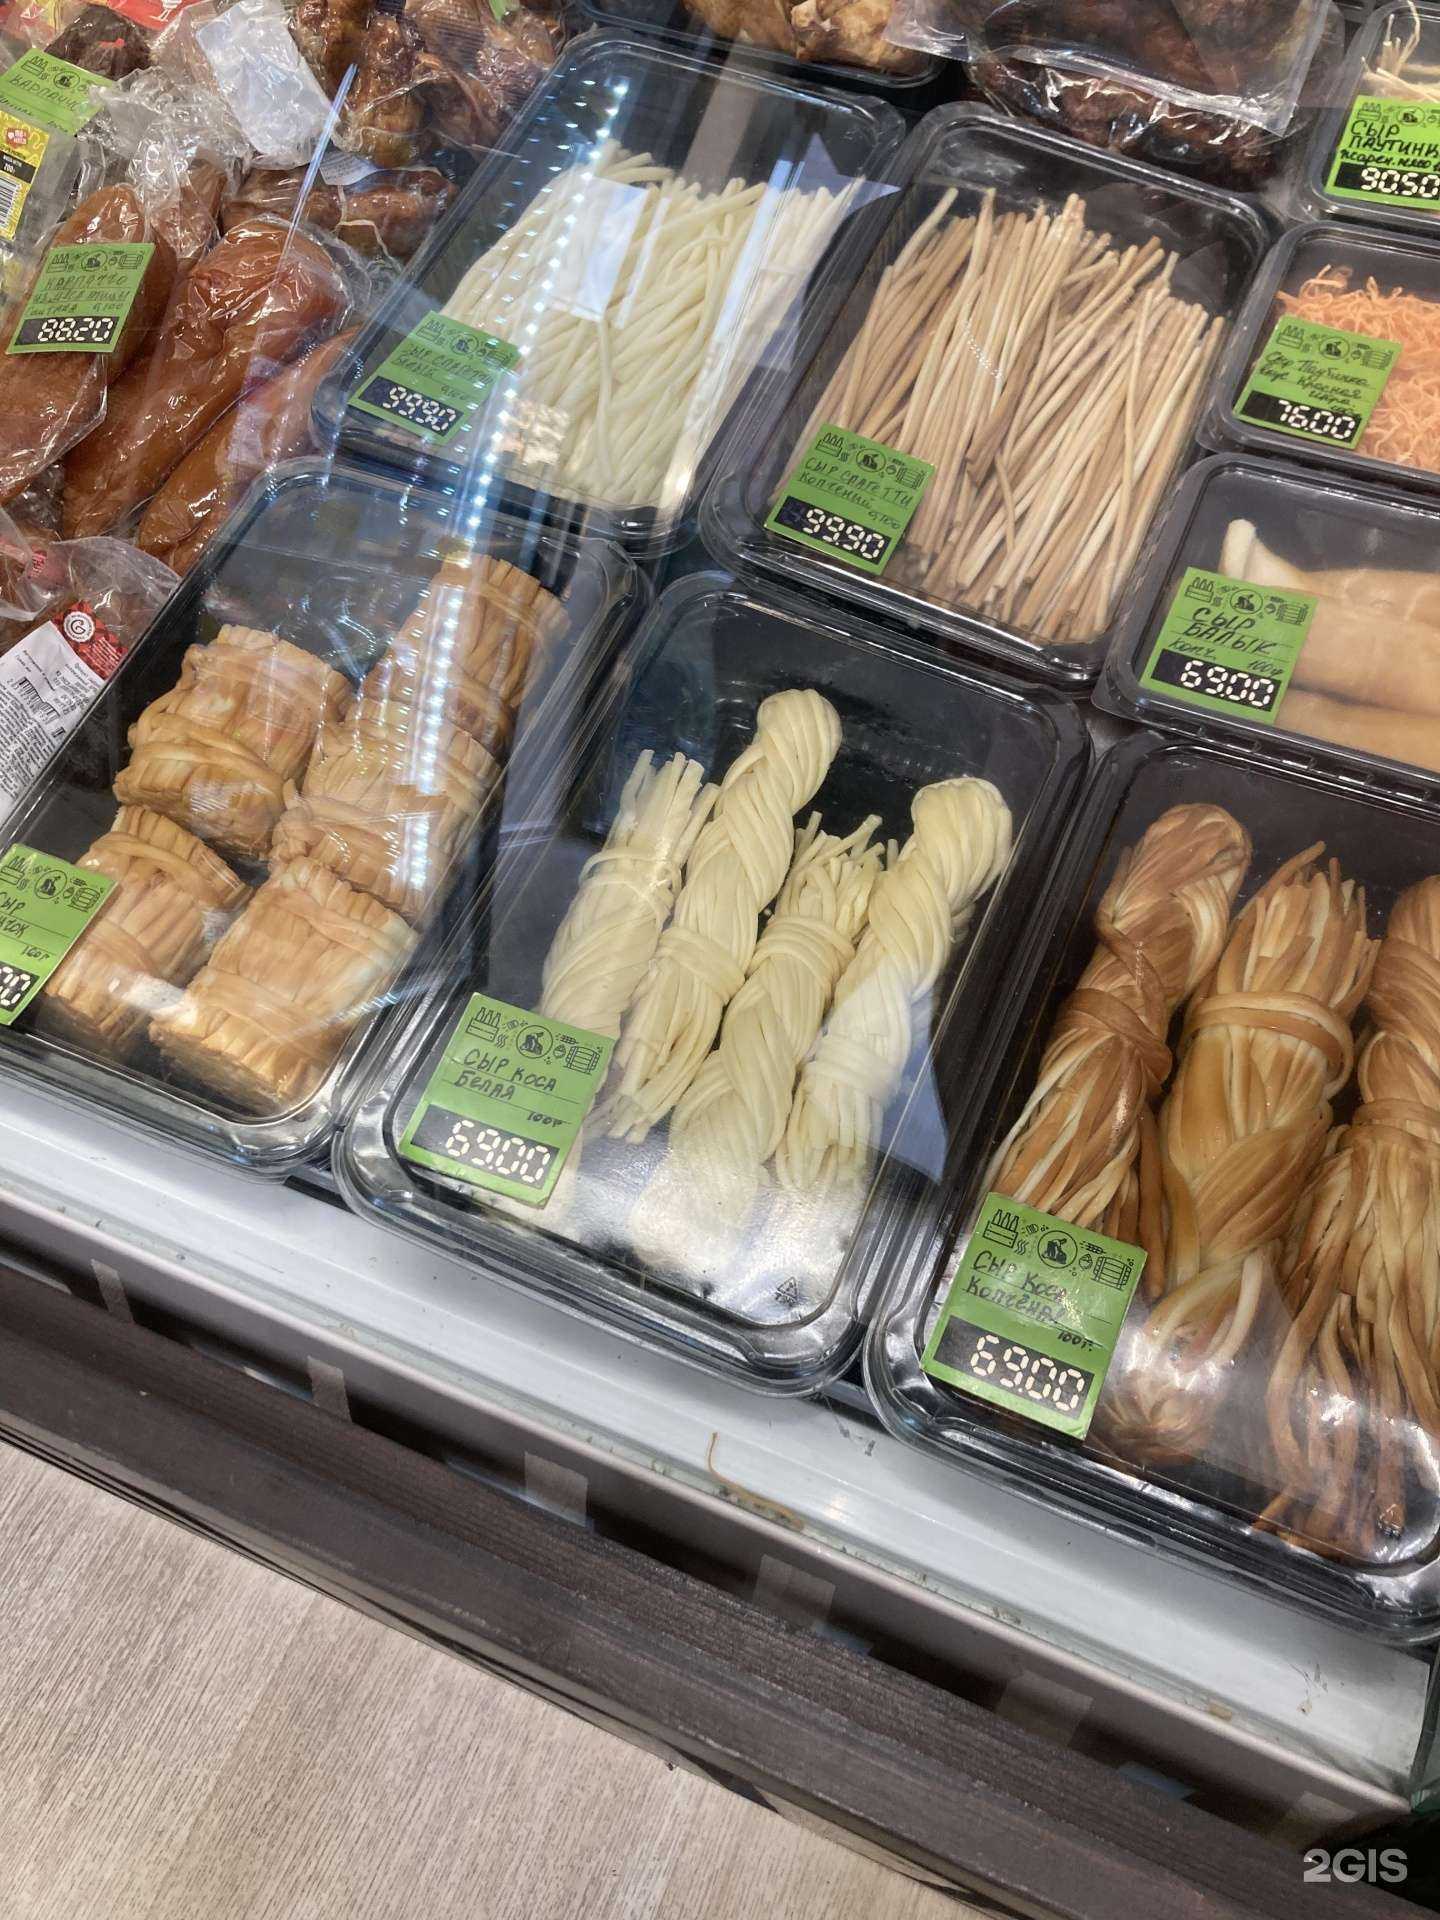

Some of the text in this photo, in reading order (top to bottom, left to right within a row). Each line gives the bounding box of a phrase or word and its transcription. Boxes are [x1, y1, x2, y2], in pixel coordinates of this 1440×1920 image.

[1351, 119, 1400, 138] СЫР
[1349, 135, 1439, 158] ПАУТИНК
[1361, 167, 1440, 197] 90.50
[38, 317, 113, 342] 88.20
[1278, 399, 1355, 439] 76.00
[805, 457, 838, 474] СЫР
[803, 508, 885, 559] 99.90
[1192, 607, 1256, 630] СЫР
[1184, 623, 1277, 655] БАЛЫК
[1180, 659, 1275, 707] 69.00
[454, 1070, 516, 1100] БЕЛАЯ
[463, 1048, 557, 1092] СЫР КОСА
[445, 1119, 551, 1184] 69.00
[973, 1250, 1017, 1279] СЫР
[970, 1334, 1085, 1411] 69.00
